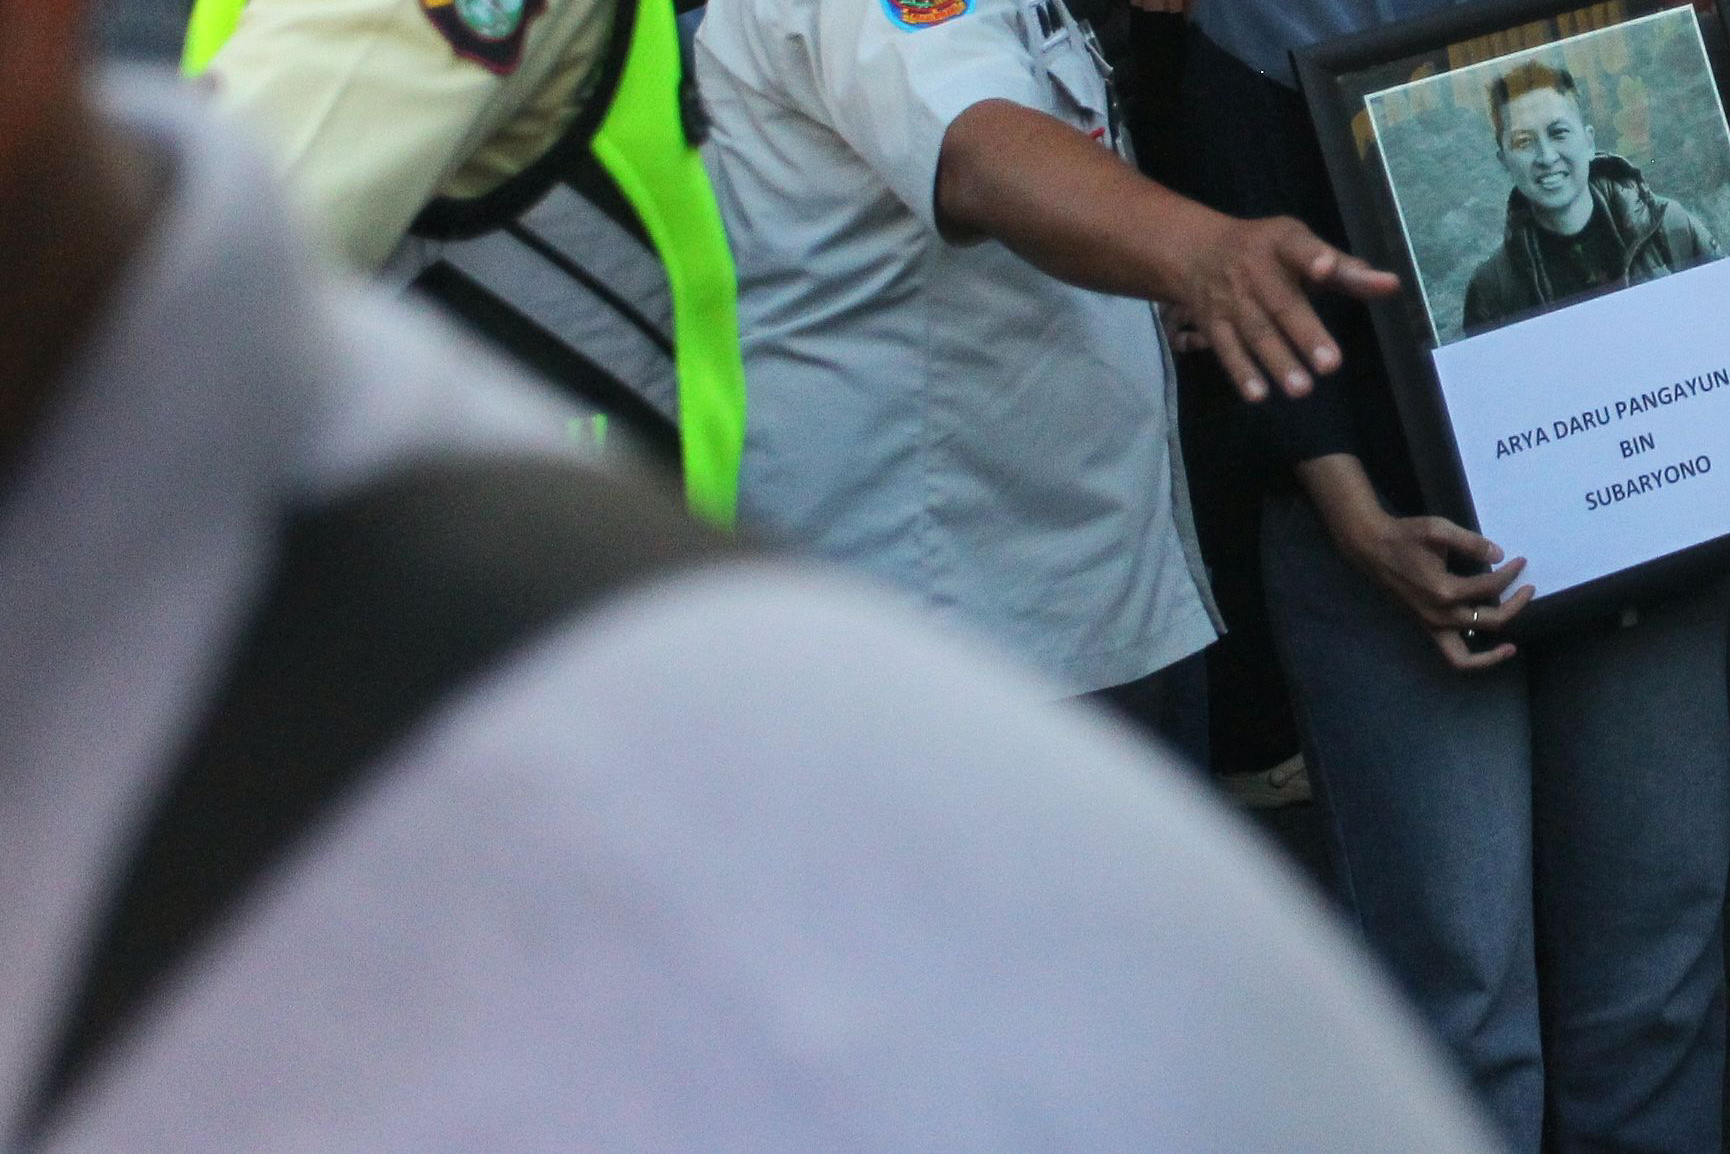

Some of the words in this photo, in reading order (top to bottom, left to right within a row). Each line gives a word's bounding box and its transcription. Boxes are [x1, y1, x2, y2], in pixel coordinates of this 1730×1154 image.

[1496, 427, 1551, 459] ARYA
[1553, 406, 1610, 440] DARU
[1619, 432, 1656, 459] BIN
[1584, 454, 1712, 511] SUBARYONO
